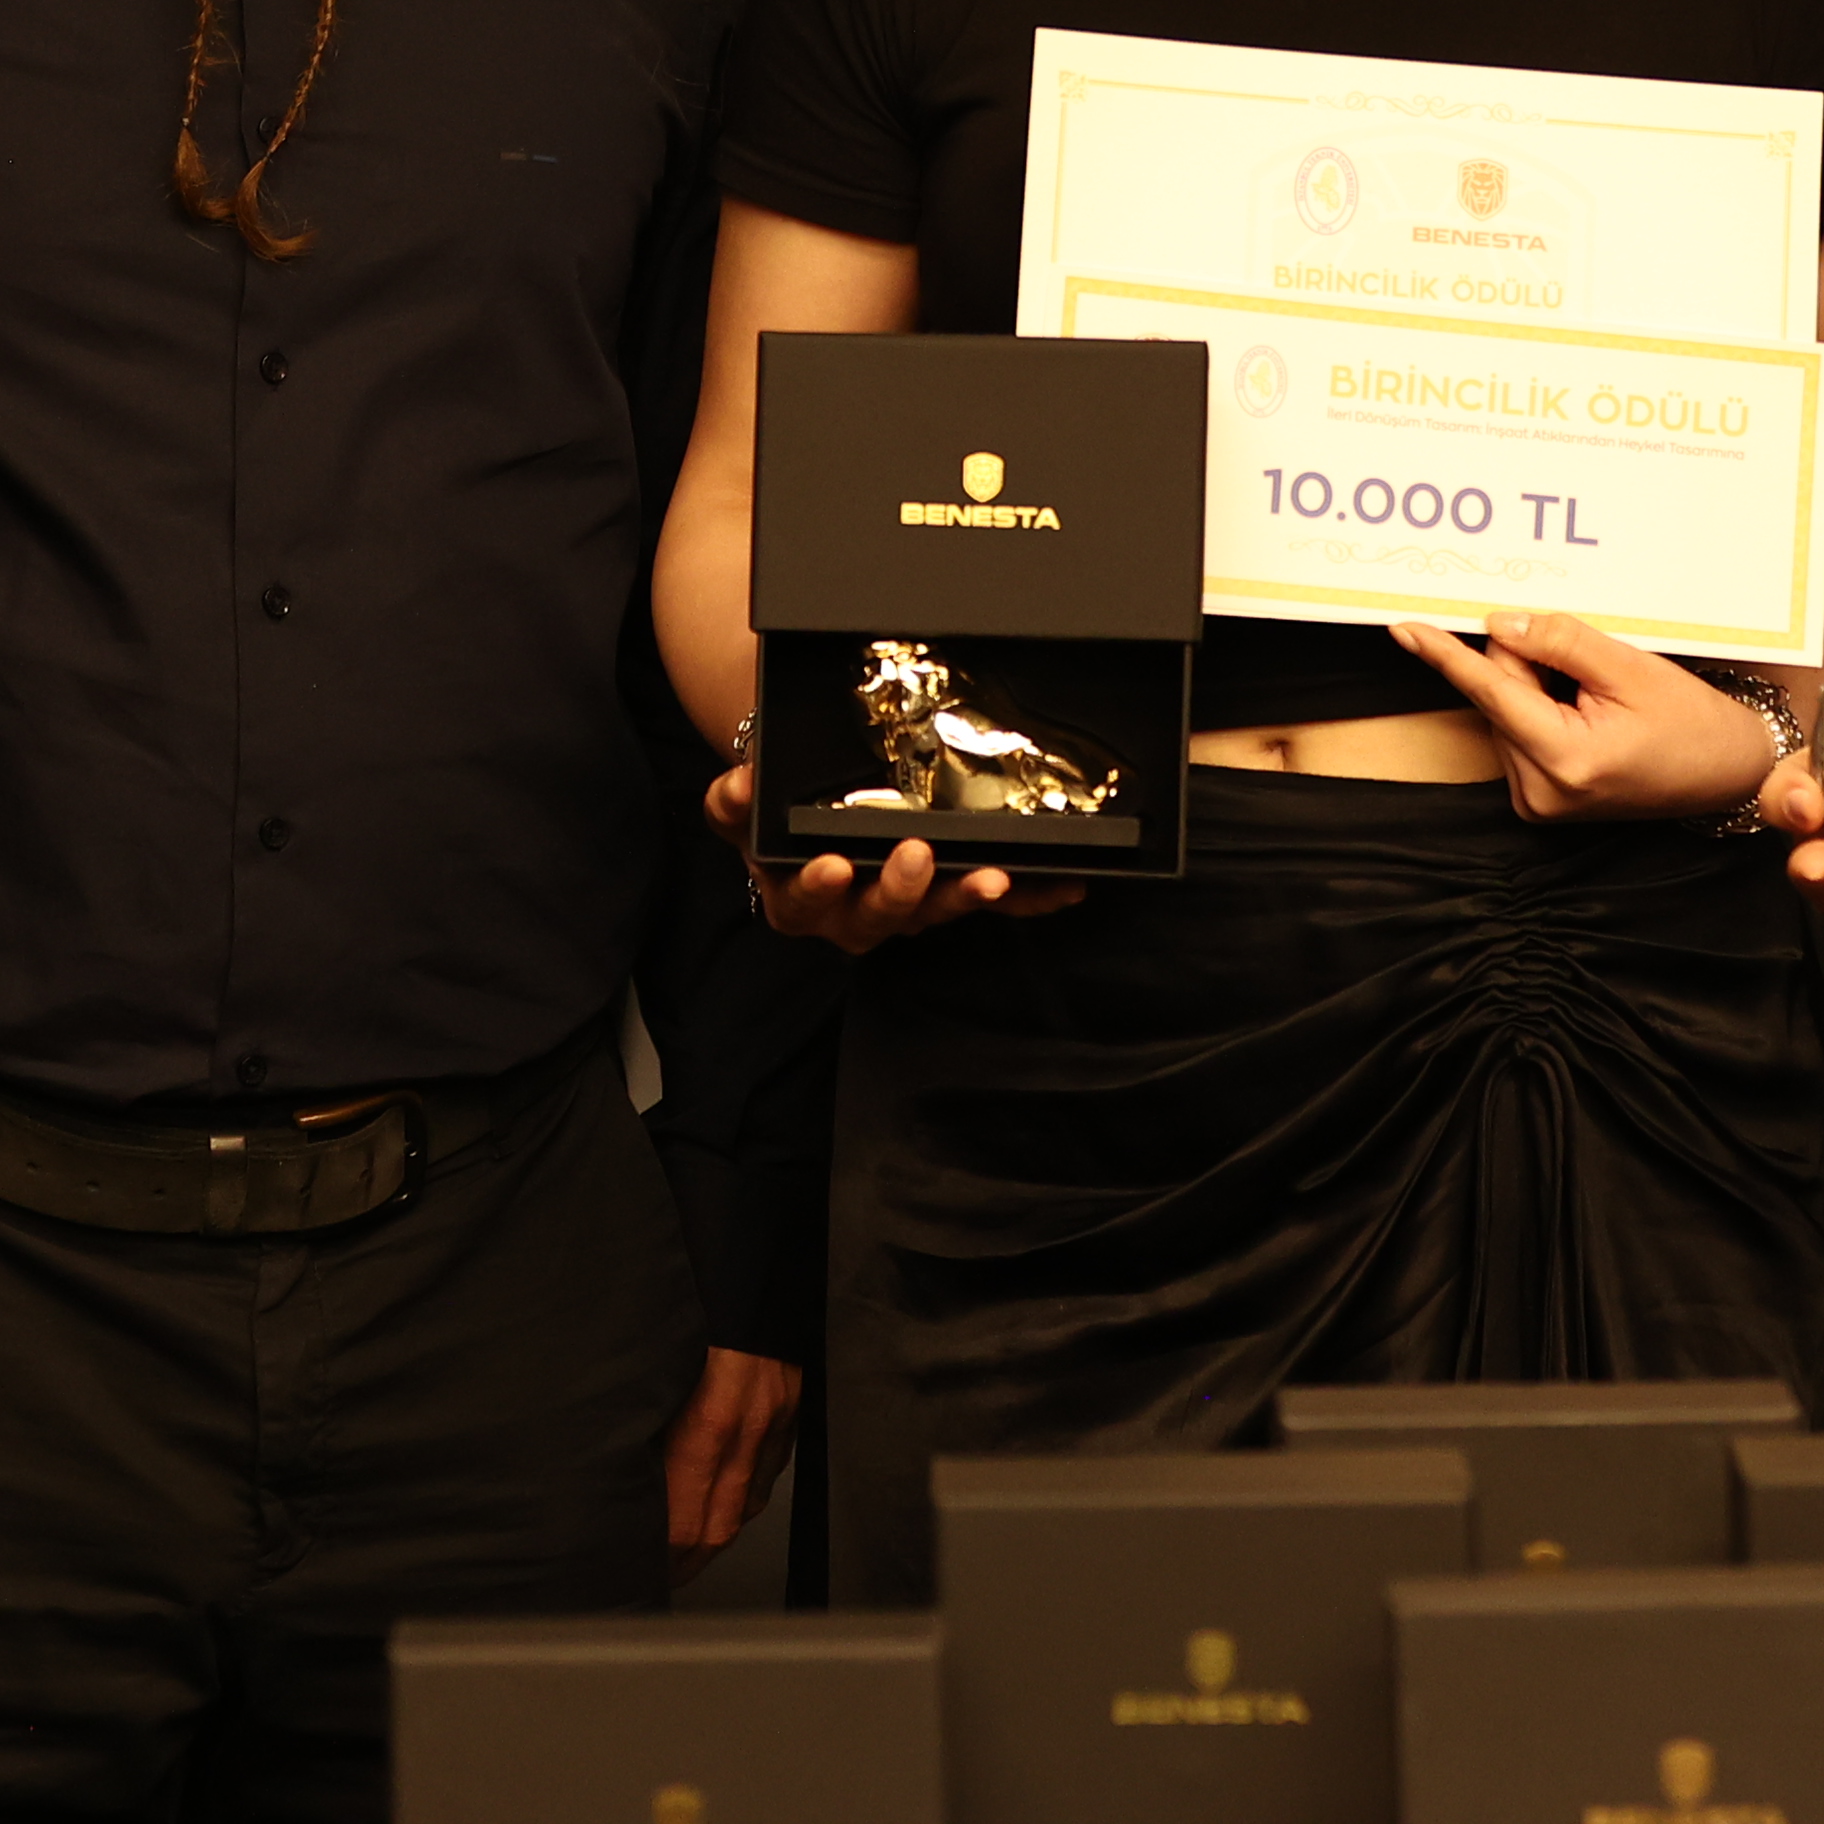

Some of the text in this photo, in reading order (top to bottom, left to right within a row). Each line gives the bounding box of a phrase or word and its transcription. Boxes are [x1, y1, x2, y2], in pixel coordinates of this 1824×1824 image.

[1412, 226, 1547, 252] BENESTA
[1274, 261, 1564, 309] BİRİNCİLİK ÖDÜLÜ
[1330, 360, 1569, 420] BİRİNCİLİK
[1587, 384, 1749, 437] ÖDÜLÜ
[1354, 411, 1422, 430] Dönüşüm
[1531, 428, 1616, 449] Atıklarından
[1618, 437, 1666, 456] Heykel
[1669, 442, 1746, 462] Tasarımına
[900, 502, 1061, 530] BENESTA
[1262, 468, 1599, 546] 10.000 TL
